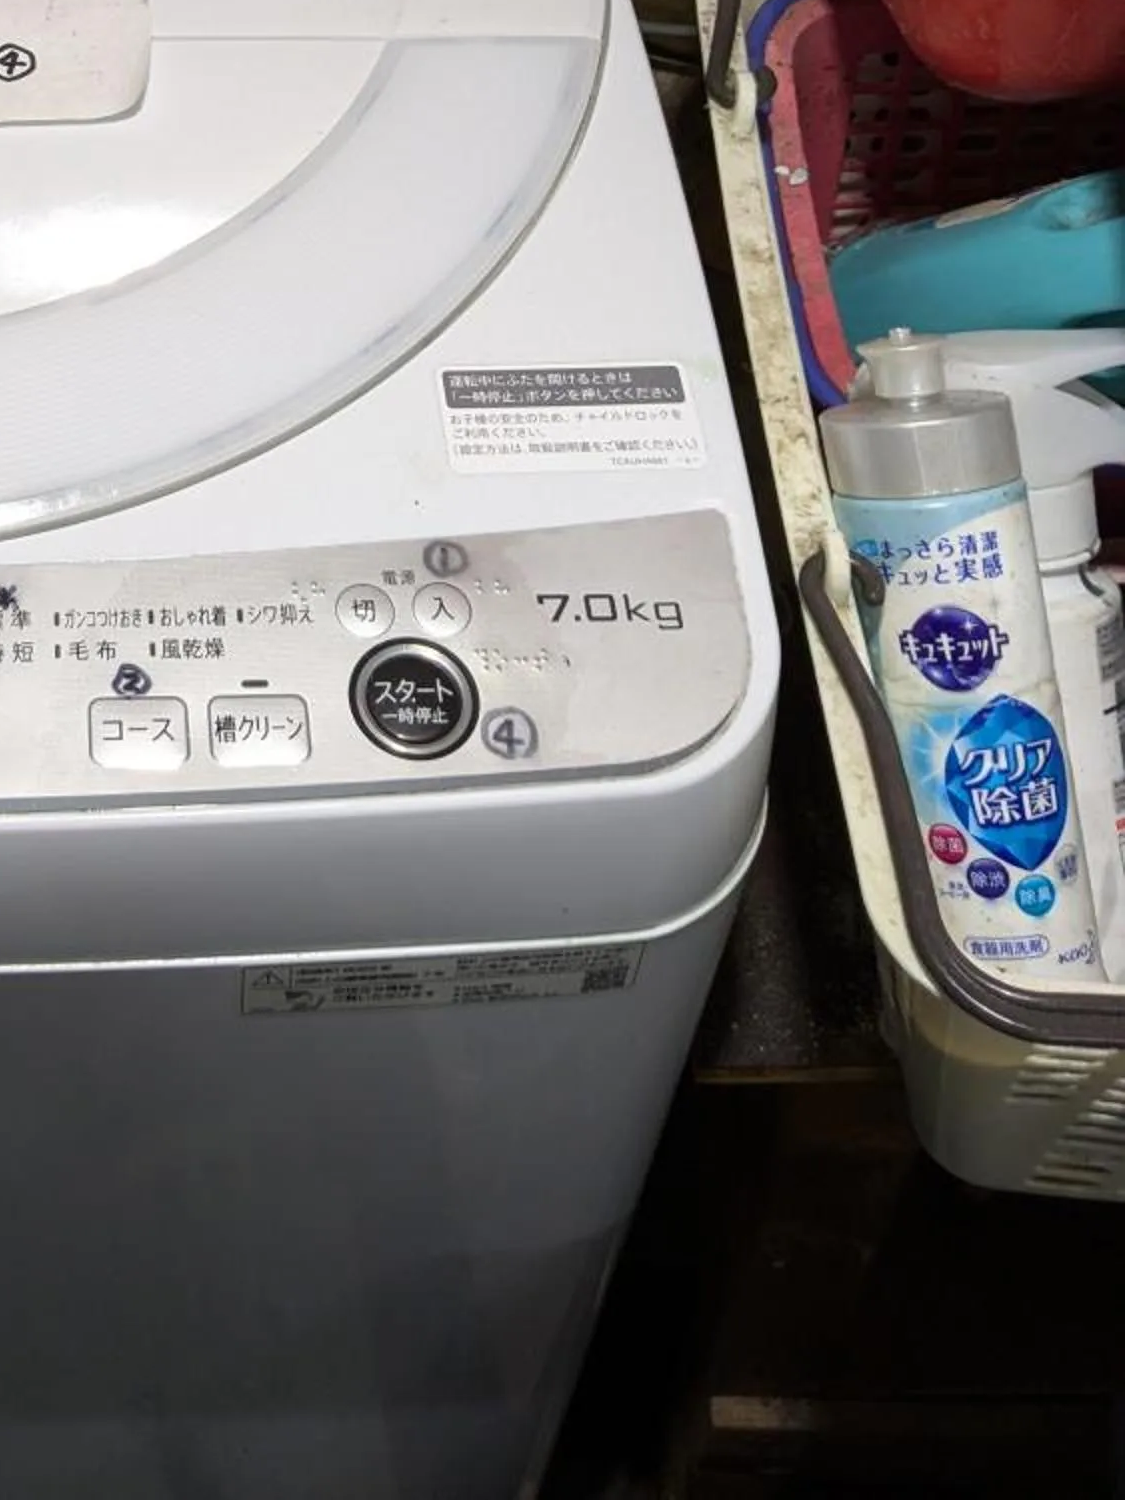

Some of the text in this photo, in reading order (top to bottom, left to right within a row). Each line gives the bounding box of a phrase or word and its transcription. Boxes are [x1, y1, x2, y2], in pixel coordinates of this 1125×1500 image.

[879, 531, 998, 560] まっさら清潔
[381, 569, 416, 586] 電源
[878, 553, 1003, 585] キュッと実感
[160, 606, 226, 627] おしゃれ着
[247, 603, 315, 625] シワ抑え
[351, 598, 376, 623] 切
[430, 597, 455, 621] 入
[536, 592, 684, 631] 7.0kg
[69, 641, 117, 661] 毛布
[161, 638, 226, 660] 風乾燥
[901, 625, 1008, 663] キュキュット
[374, 678, 454, 704] スタート
[381, 707, 449, 725] 一時停止
[102, 718, 175, 742] コース
[214, 715, 304, 744] 槽クリーン
[960, 738, 1052, 786] クリア
[972, 778, 1058, 826] 除菌
